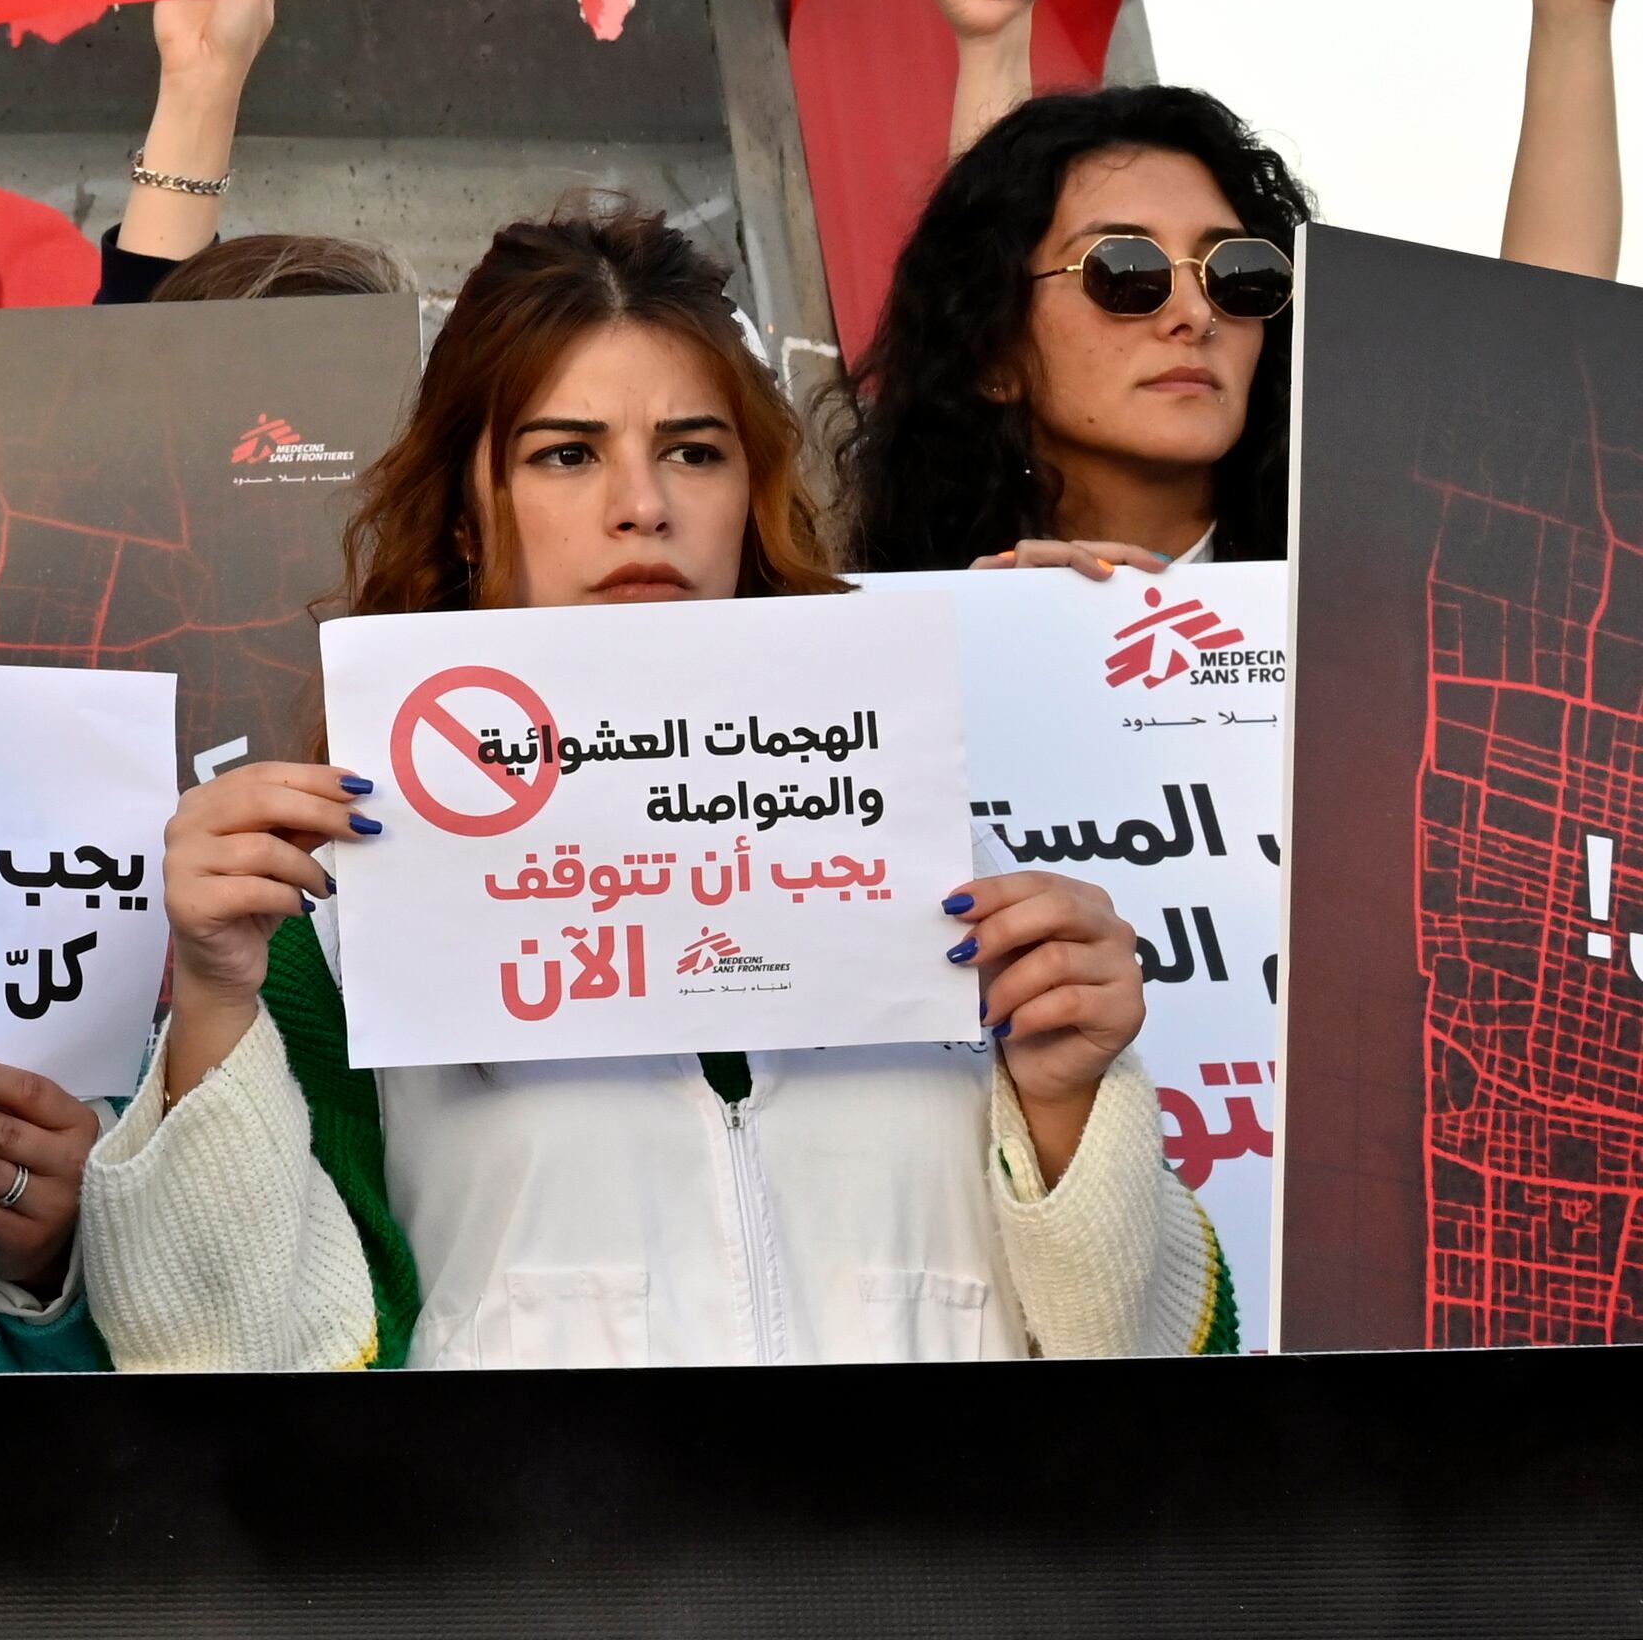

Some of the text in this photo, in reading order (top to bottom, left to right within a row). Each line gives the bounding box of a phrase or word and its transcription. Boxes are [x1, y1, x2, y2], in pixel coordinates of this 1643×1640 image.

[1189, 666, 1240, 687] SANS
[1199, 649, 1286, 669] MEDECIN
[477, 710, 880, 779] الهجمات العشوائية
[646, 775, 886, 832] والمتواصلة
[484, 835, 893, 913] يجب أن تتوقف
[500, 924, 647, 1023] الآن
[718, 956, 764, 965] MEDECINS
[737, 963, 792, 973] FRONTIERES
